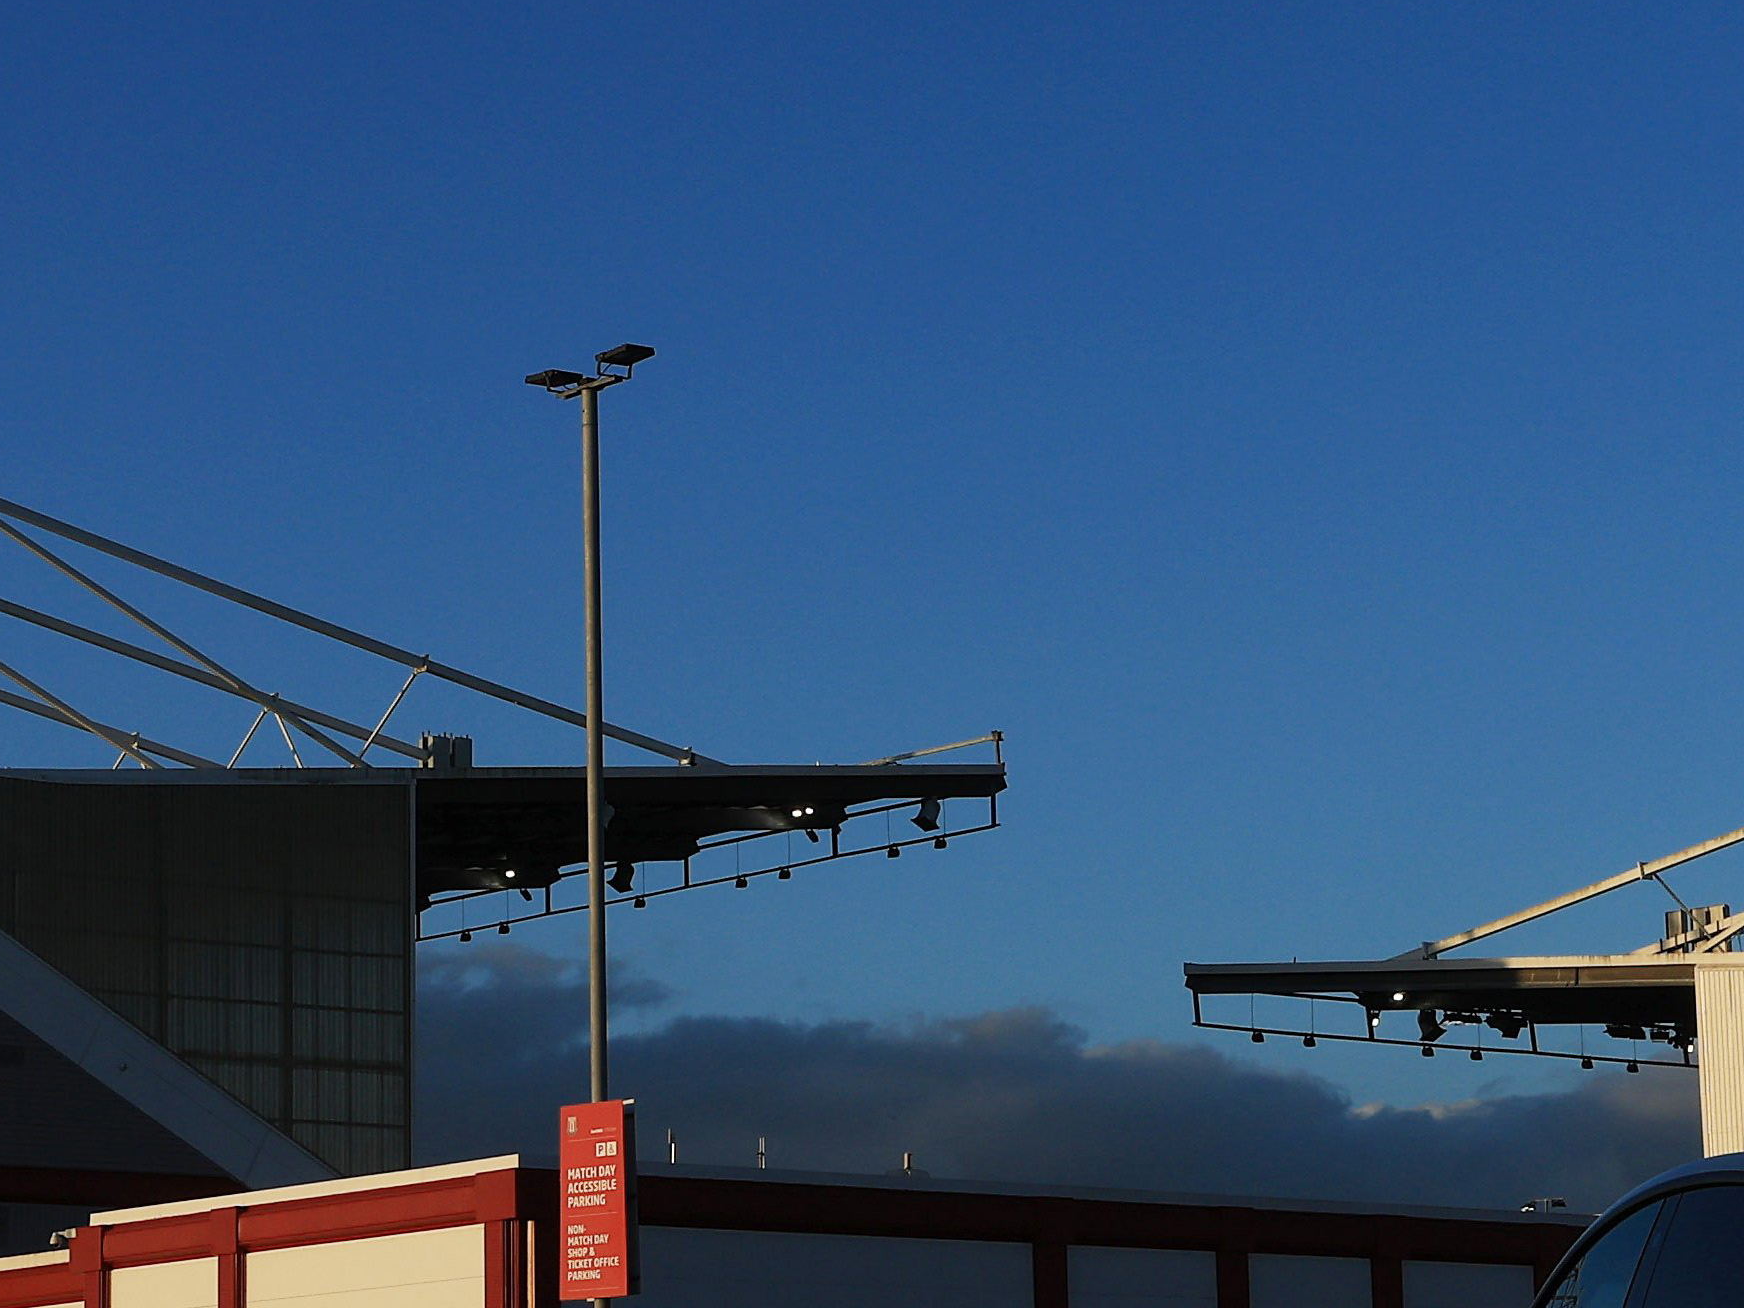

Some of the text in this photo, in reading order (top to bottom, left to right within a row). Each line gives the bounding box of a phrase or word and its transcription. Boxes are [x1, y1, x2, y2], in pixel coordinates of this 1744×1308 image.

[567, 1164, 616, 1181] MATCH DAY
[567, 1178, 617, 1194] ACCESSIBLE
[567, 1194, 606, 1209] PARKING
[567, 1224, 587, 1235] NON-
[567, 1234, 609, 1247] MATCH DAY
[567, 1246, 596, 1259] SHOP &
[567, 1256, 620, 1270] TICKET OFFICE
[567, 1269, 601, 1281] PARKING
